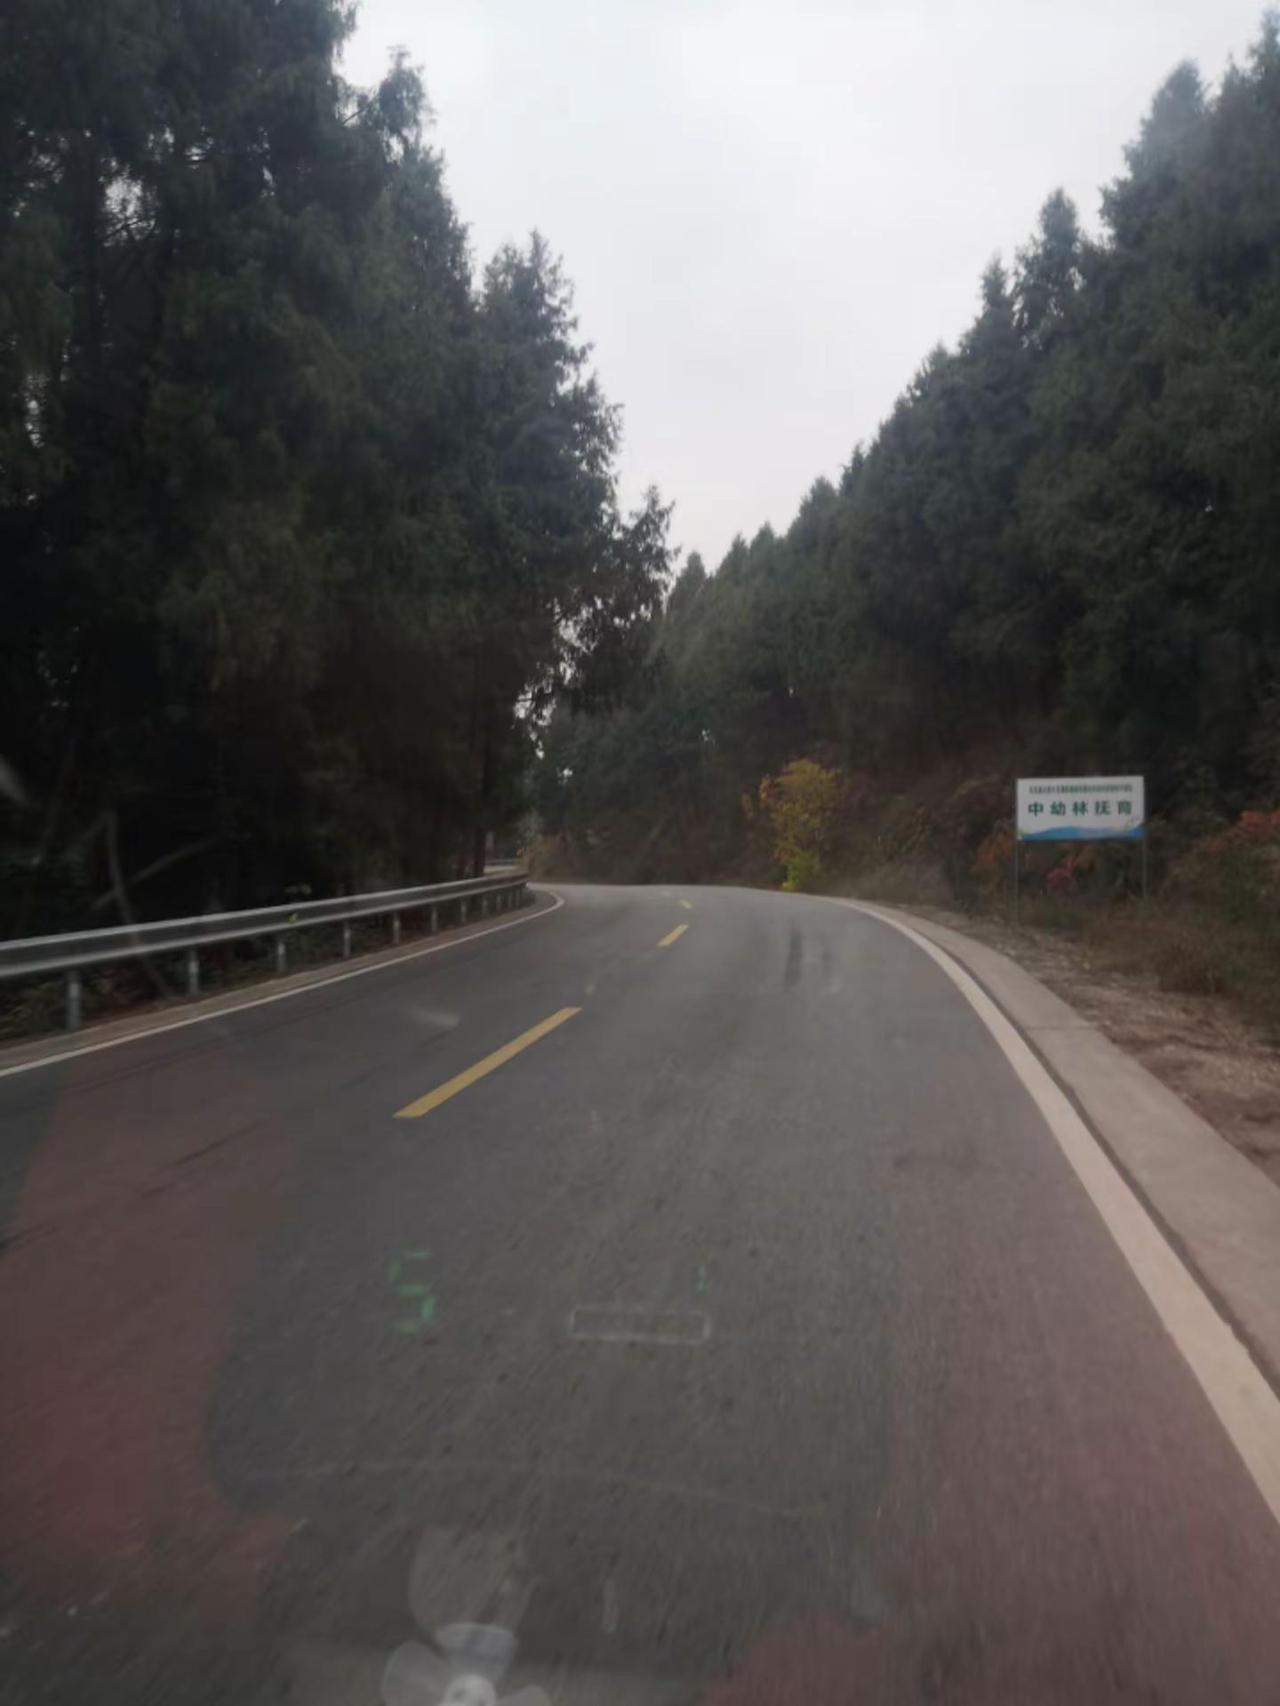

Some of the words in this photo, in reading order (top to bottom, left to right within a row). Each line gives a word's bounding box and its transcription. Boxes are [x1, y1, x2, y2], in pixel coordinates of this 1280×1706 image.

[1028, 800, 1132, 816] 中幼林抚育
